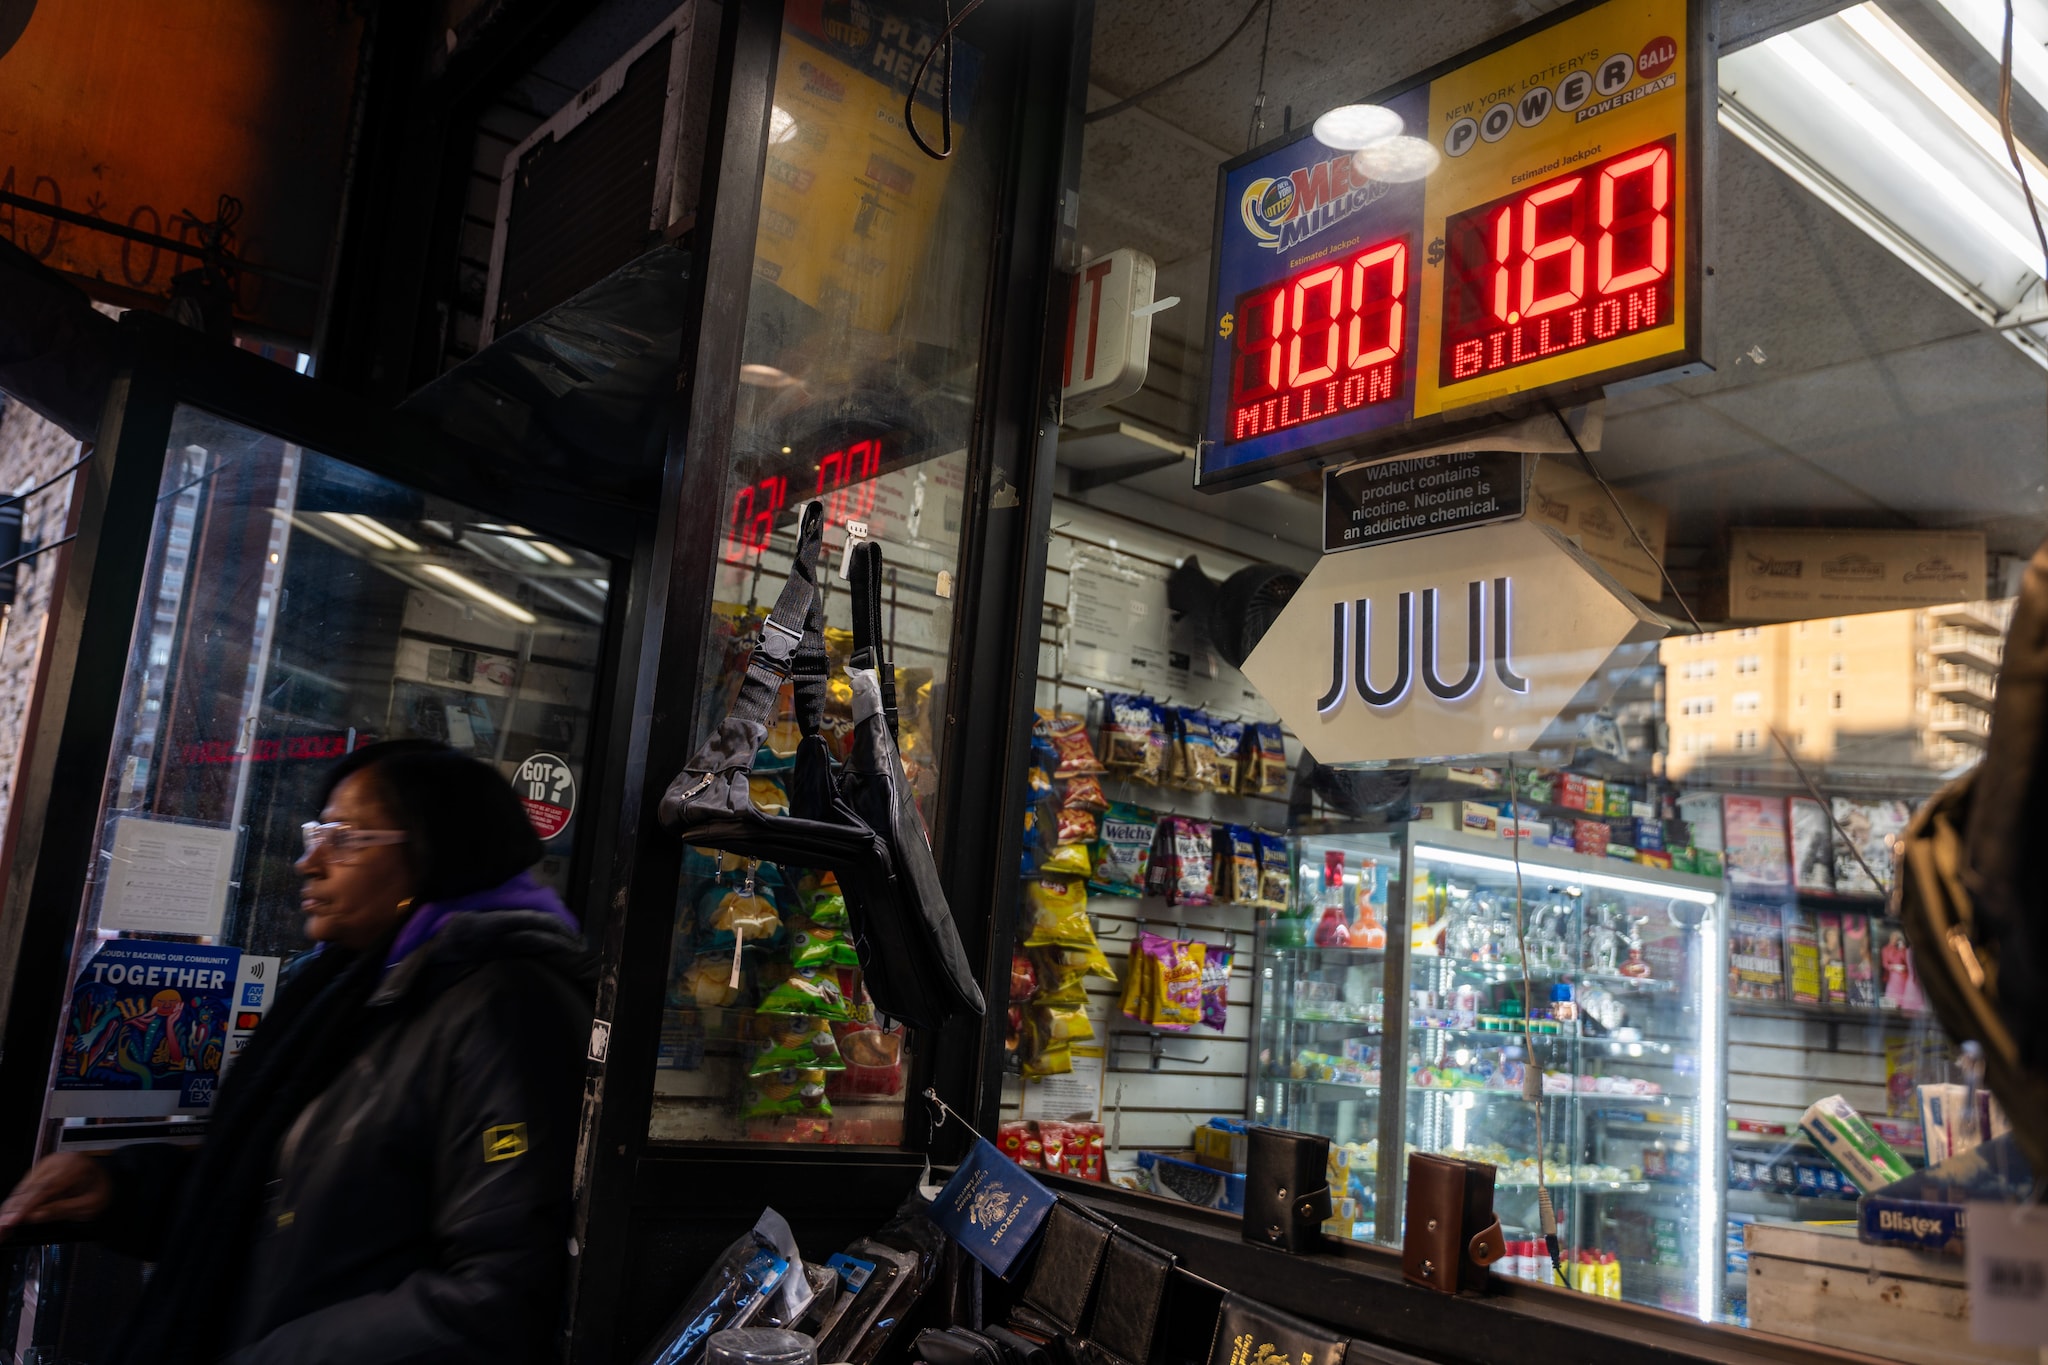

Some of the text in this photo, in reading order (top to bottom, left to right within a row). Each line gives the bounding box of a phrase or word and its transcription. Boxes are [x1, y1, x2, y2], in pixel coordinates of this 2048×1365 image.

[881, 15, 946, 68] PLAY
[1639, 43, 1675, 71] BALL
[872, 42, 944, 99] HERE
[1446, 48, 1600, 122] NEW YORK LOTTERY'S
[1451, 59, 1628, 152] POWER
[1511, 143, 1602, 186] Estimated Jackpot
[1290, 236, 1360, 268] Estimated Jackpot
[1268, 242, 1407, 391] 100
[1453, 286, 1657, 381] BILLION
[1235, 365, 1393, 441] MILLION
[1361, 465, 1480, 504] product contains
[1366, 455, 1440, 481] WARNING:
[1343, 497, 1500, 540] an addictive chemical.
[1352, 481, 1490, 521] nicotine. Nicotine is
[1317, 577, 1530, 714] JUUL
[522, 761, 553, 782] GOT
[528, 781, 545, 801] ID
[1105, 823, 1151, 841] Welch's
[92, 962, 226, 990] TOGETHER
[101, 949, 230, 966] ROUDLY BACKING OUR COMMUNITY
[990, 1194, 1030, 1246] PASSPORT
[1879, 1209, 1942, 1238] Blistex
